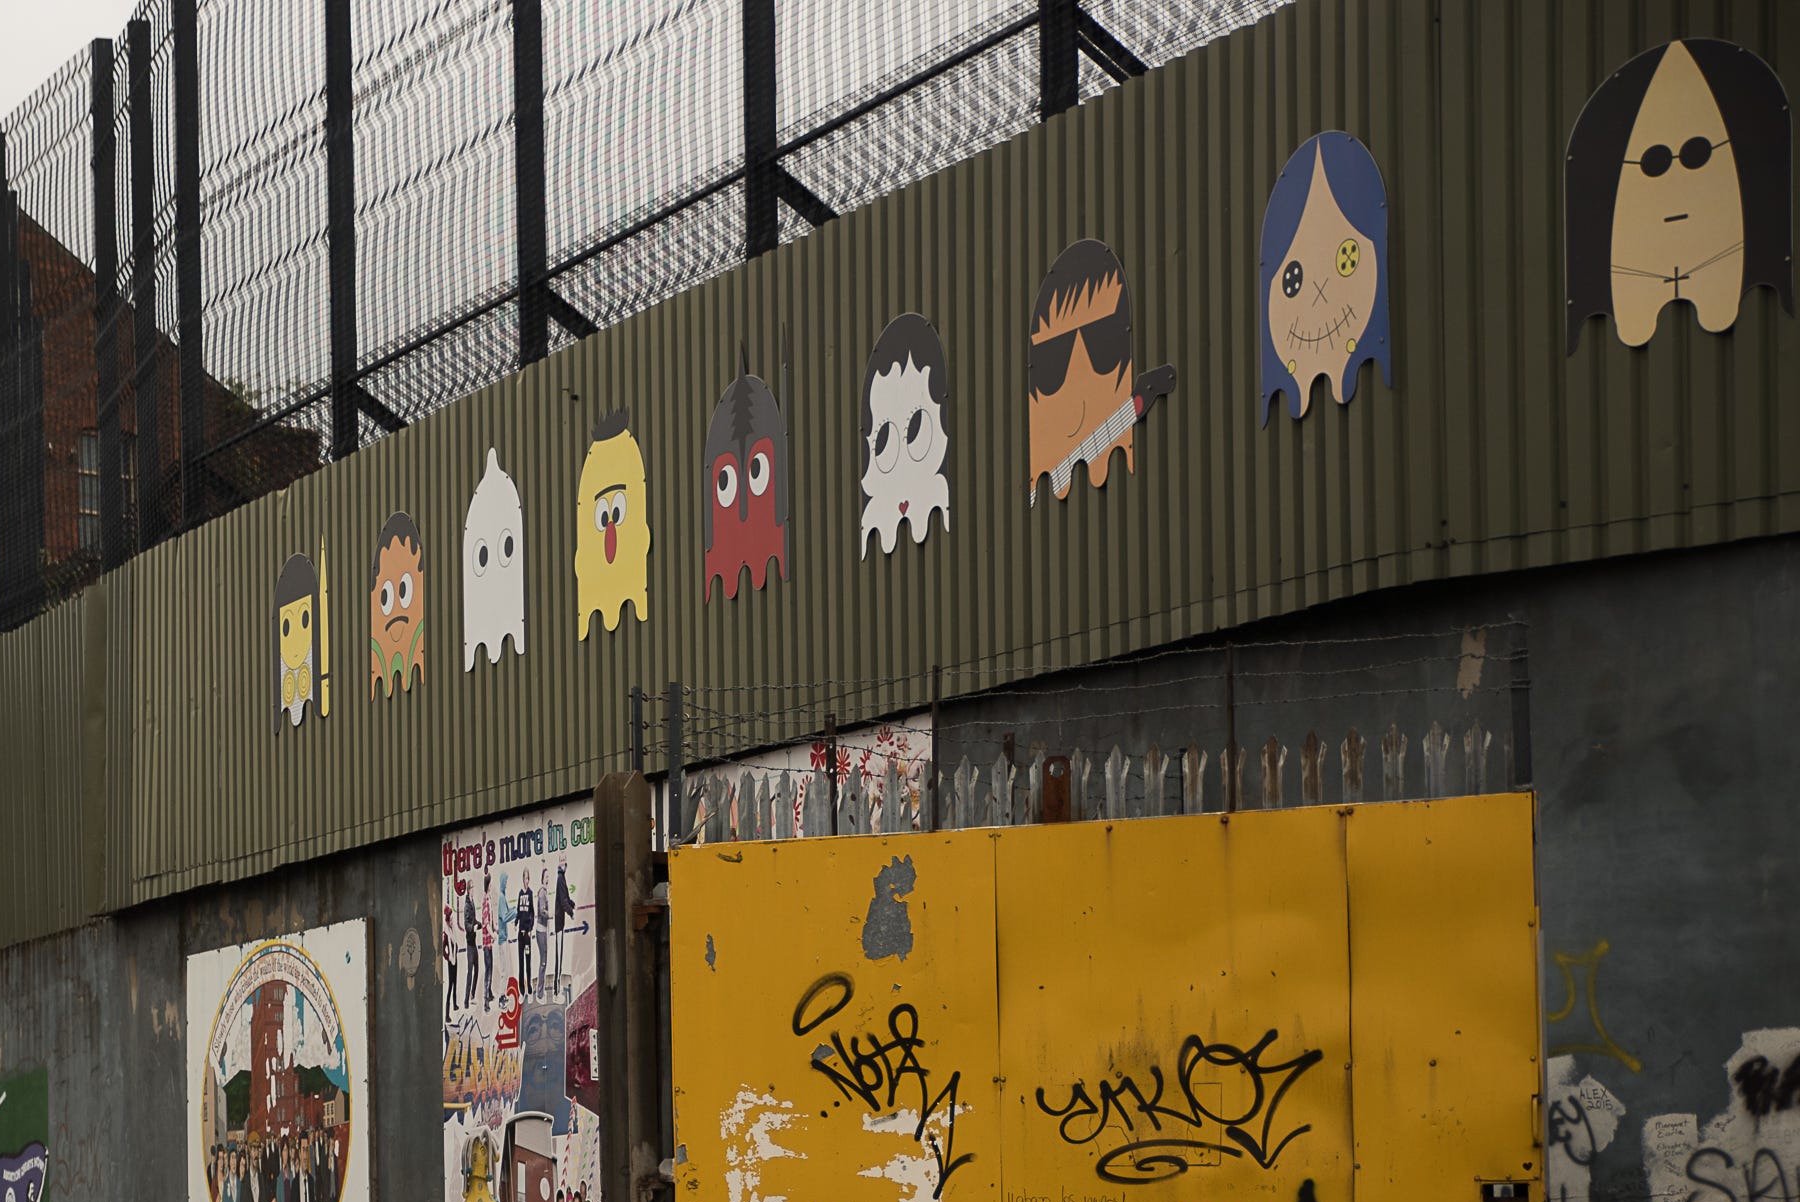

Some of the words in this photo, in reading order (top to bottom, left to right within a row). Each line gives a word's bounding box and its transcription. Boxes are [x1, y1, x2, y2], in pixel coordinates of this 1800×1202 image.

[443, 833, 496, 893] there's
[499, 828, 544, 864] more
[547, 820, 567, 853] in
[1579, 1088, 1608, 1100] ALEX
[1586, 1100, 1614, 1111] 2015
